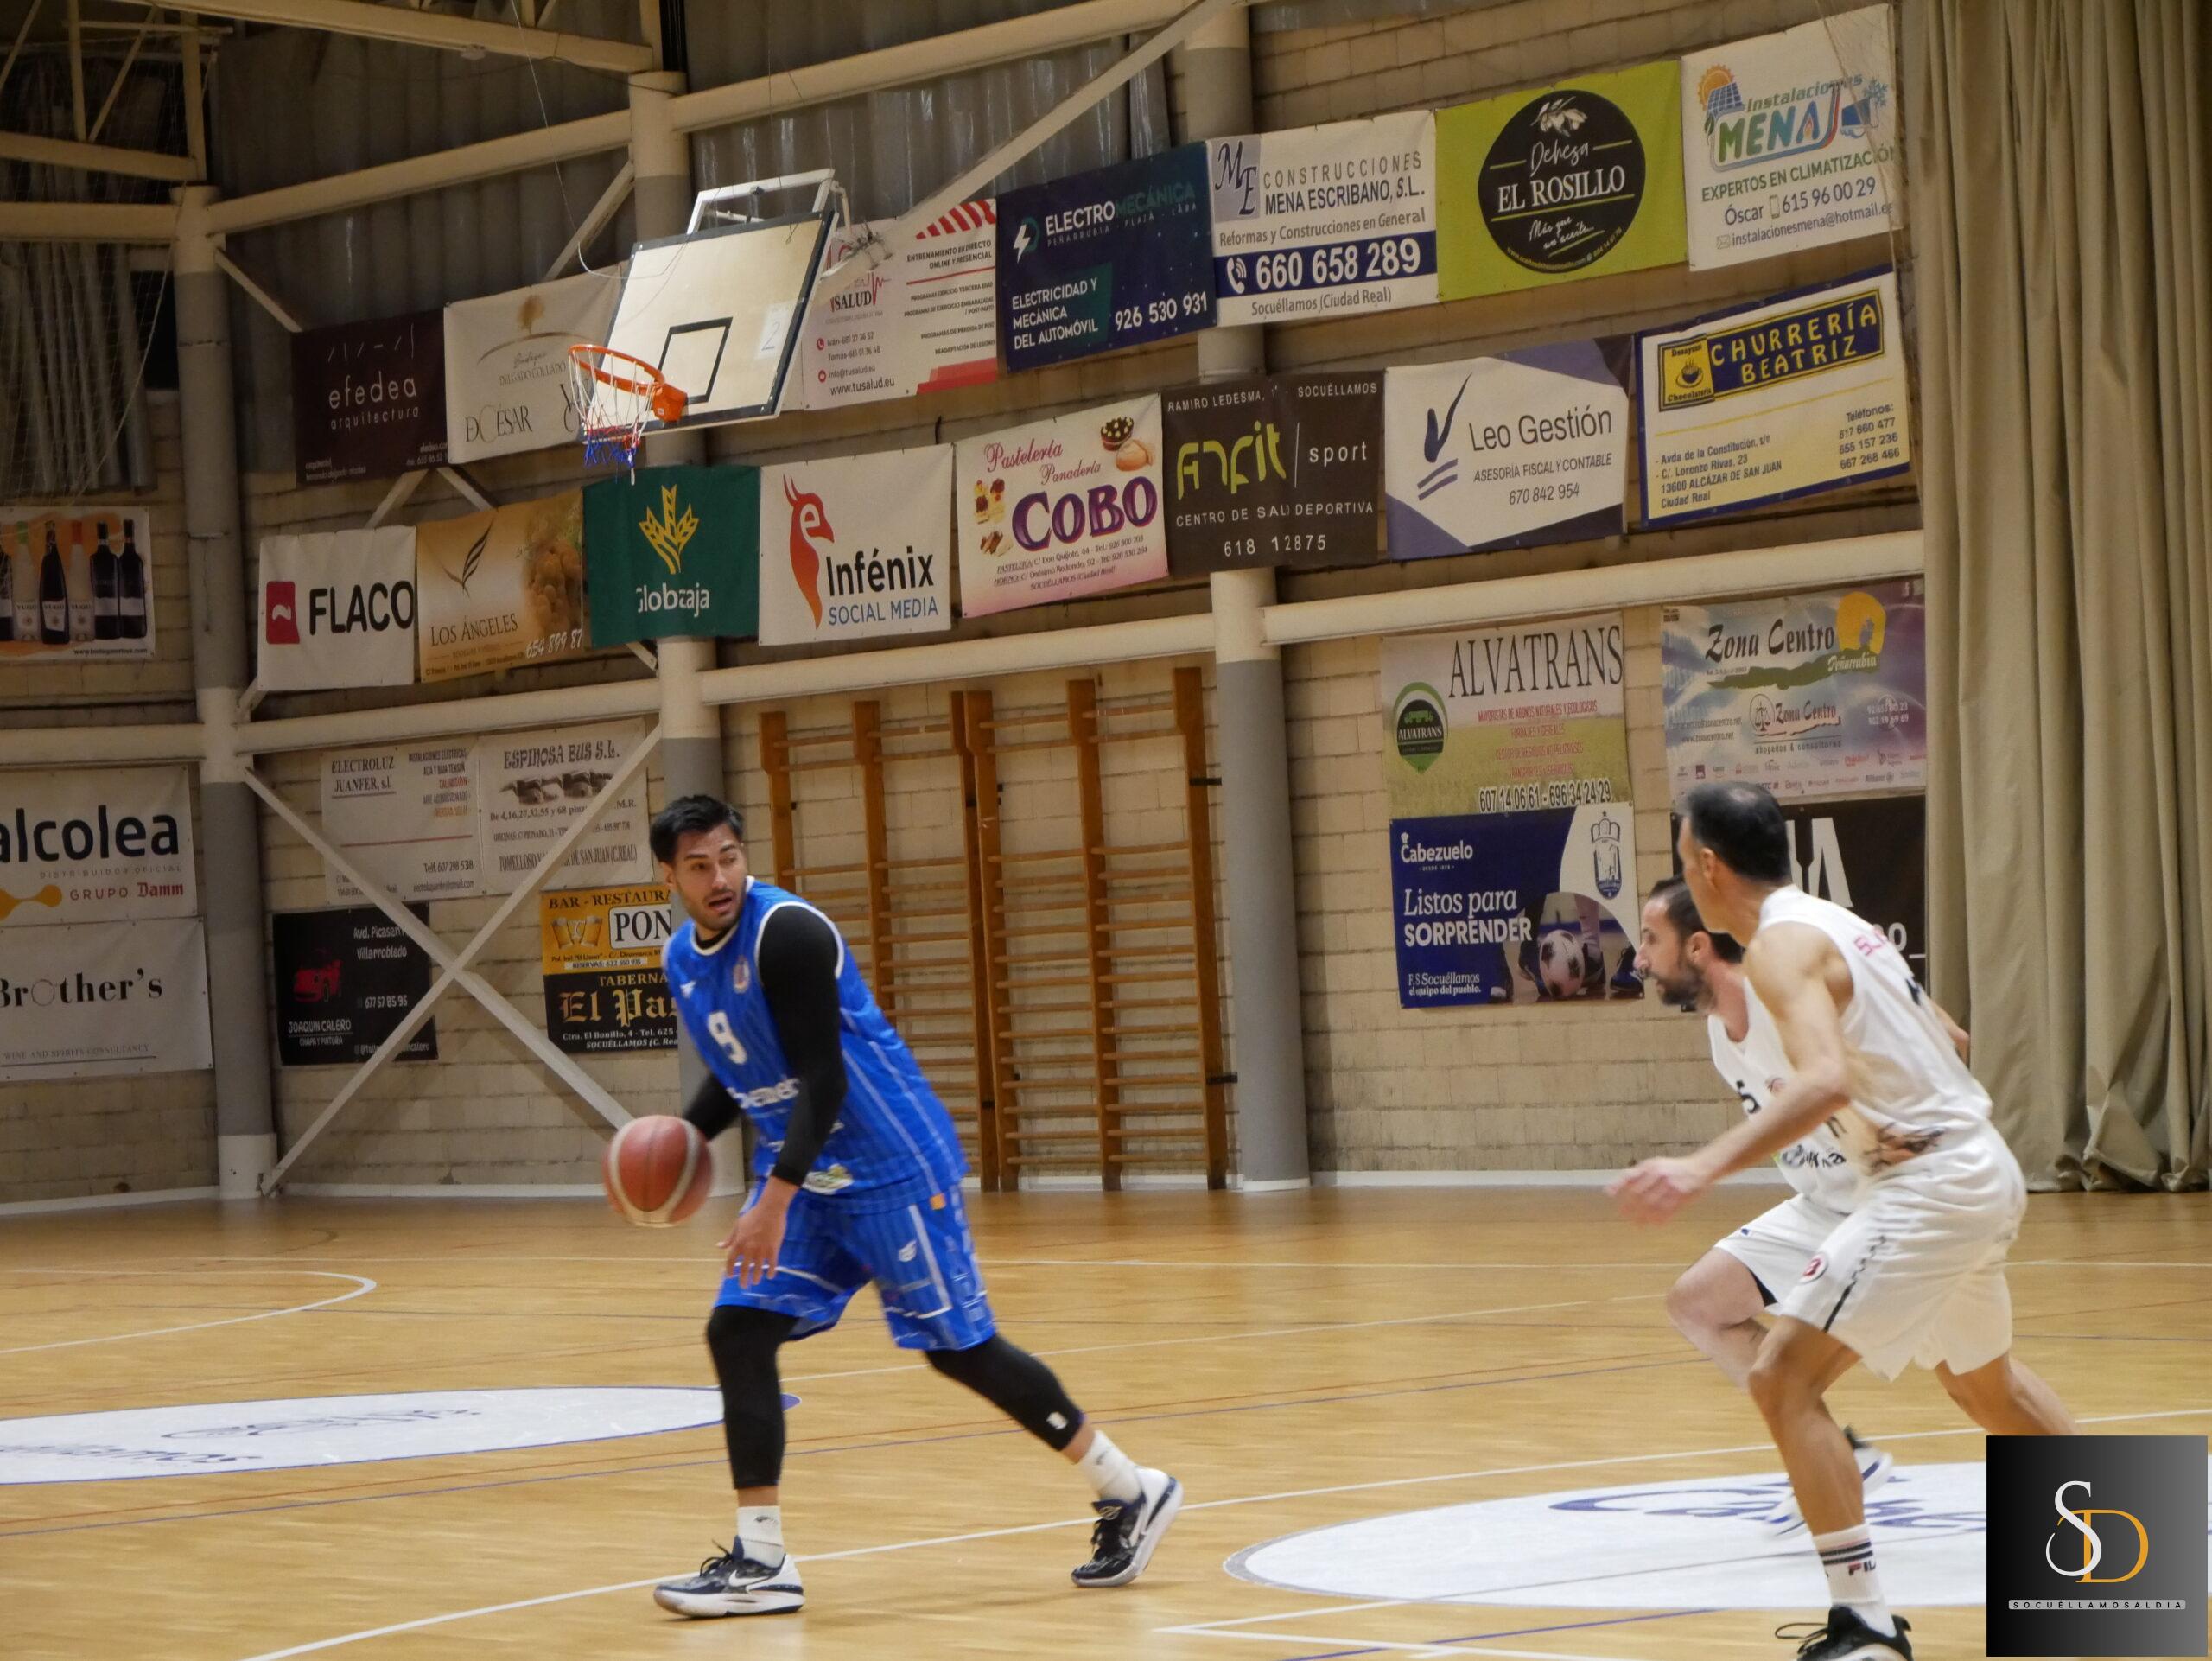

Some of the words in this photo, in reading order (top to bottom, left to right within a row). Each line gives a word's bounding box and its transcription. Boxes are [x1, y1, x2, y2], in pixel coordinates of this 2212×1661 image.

[1719, 100, 1820, 163] MENA
[1263, 150, 1422, 190] CONSTRUCCIONES
[1529, 139, 1590, 178] Dehesa
[1265, 192, 1305, 216] MENA
[1308, 178, 1393, 211] ESCRIBANO,
[1396, 176, 1425, 198] S.L.
[1497, 183, 1526, 213] EL
[1529, 164, 1626, 207] ROSILLO
[1701, 175, 1767, 203] EXPERTOS
[1770, 172, 1788, 188] EN
[1724, 203, 1764, 226] Óscar
[1782, 191, 1808, 213] 615
[1811, 187, 1830, 207] 96
[1833, 181, 1853, 201] 00
[1856, 176, 1876, 198] 29
[1219, 228, 1268, 247] Reformas
[1271, 230, 1277, 245] y
[1279, 217, 1361, 241] Construcciones
[1363, 218, 1376, 230] en
[1378, 207, 1426, 227] General
[907, 247, 957, 262] ENTRENAMIENTO
[1255, 251, 1304, 290] 660
[1312, 245, 1358, 284] 658
[1365, 237, 1421, 278] 289
[1012, 279, 1088, 310] ELECTRICIDAD
[1090, 277, 1097, 291] Y
[1251, 296, 1318, 316] Socuéllamos
[1319, 292, 1360, 313] (Ciudad
[1363, 286, 1392, 303] Real)
[1013, 306, 1067, 330] MECÁNICA
[1116, 305, 1143, 332] 926
[1148, 298, 1177, 324] 530
[1182, 290, 1207, 315] 931
[1014, 334, 1035, 350] DEL
[1038, 318, 1099, 346] AUTOMÓVIL
[1710, 302, 1878, 366] CHURRERÍA
[1741, 334, 1857, 384] BEATRIZ
[328, 371, 416, 410] efedea
[1297, 382, 1378, 398] SOCUÉLLAMOS
[1167, 397, 1208, 412] RAMIRO
[1846, 404, 1894, 423] Teléfonos:
[331, 406, 419, 432] arquitectura
[1469, 423, 1511, 451] Leo
[1518, 404, 1612, 445] Gestión
[984, 438, 1064, 473] Pastelería
[1309, 442, 1367, 467] sport
[1684, 450, 1694, 461] de
[1697, 448, 1705, 458] la
[1859, 436, 1876, 449] 157
[1039, 459, 1102, 486] Panadería
[1473, 462, 1521, 482] ASESORÍA
[1522, 460, 1554, 476] FISCAL
[1556, 460, 1561, 472] Y
[1562, 453, 1612, 472] CONTABLE
[1730, 469, 1741, 481] DE
[1743, 465, 1760, 479] SAN
[1762, 460, 1783, 474] JUAN
[1738, 453, 1748, 466] 23
[1509, 489, 1530, 506] 670
[1532, 485, 1554, 503] 842
[1558, 482, 1580, 500] 954
[1661, 493, 1689, 508] Ciudad
[1692, 490, 1711, 503] Real
[1012, 475, 1158, 552] COBO
[1176, 510, 1226, 528] CENTRO
[1231, 507, 1249, 522] DE
[1295, 501, 1374, 516] DEPORTIVA
[1224, 538, 1255, 557] 618
[825, 545, 934, 596] Infénix
[309, 580, 415, 636] FLACO
[829, 601, 886, 627] SOCIAL
[890, 596, 938, 620] MEDIA
[430, 625, 457, 647] LOS
[461, 613, 518, 642] ÁNGELES
[1705, 623, 1759, 663] Zona
[1768, 618, 1835, 655] Centro
[524, 640, 545, 659] 654
[1448, 625, 1623, 698] ALVATRANS
[1827, 651, 1878, 672] Peñarrubia
[1775, 702, 1802, 724] Zona
[1803, 700, 1837, 720] Centro
[1397, 726, 1442, 741] ALVATRANS
[331, 756, 394, 774] ELECTROLUZ
[504, 745, 564, 769] ESPINOSA
[568, 741, 592, 762] BUS
[334, 777, 380, 792] JUANFER,
[1479, 789, 1496, 811] 607
[1499, 788, 1511, 810] 14
[1514, 786, 1526, 808] 06
[1529, 785, 1541, 806] 61
[1549, 784, 1568, 806] 696
[1570, 782, 1581, 805] 34
[1584, 781, 1596, 803] 24
[1598, 780, 1611, 802] 29
[1401, 839, 1473, 863] Cabezuelo
[40, 868, 129, 880] DISTRIBUIDOR
[461, 860, 474, 870] 538
[70, 888, 129, 901] GRUPO
[137, 881, 184, 897] Damm
[549, 898, 580, 909] BAR
[1404, 888, 1462, 917] Listos
[1467, 889, 1517, 919] para
[1404, 917, 1533, 948] SORPRENDER
[356, 945, 407, 960] Villarrobledo
[599, 972, 668, 987] TABERNA
[1421, 971, 1480, 986] Socuéllamos
[1440, 984, 1452, 995] del
[397, 995, 408, 1007] 95
[558, 989, 602, 1023] El
[288, 1021, 321, 1034] JOAQUIN
[321, 1019, 352, 1031] CALERO
[708, 1011, 748, 1065] 9
[586, 1038, 647, 1049] SOCUÉLLAMOS
